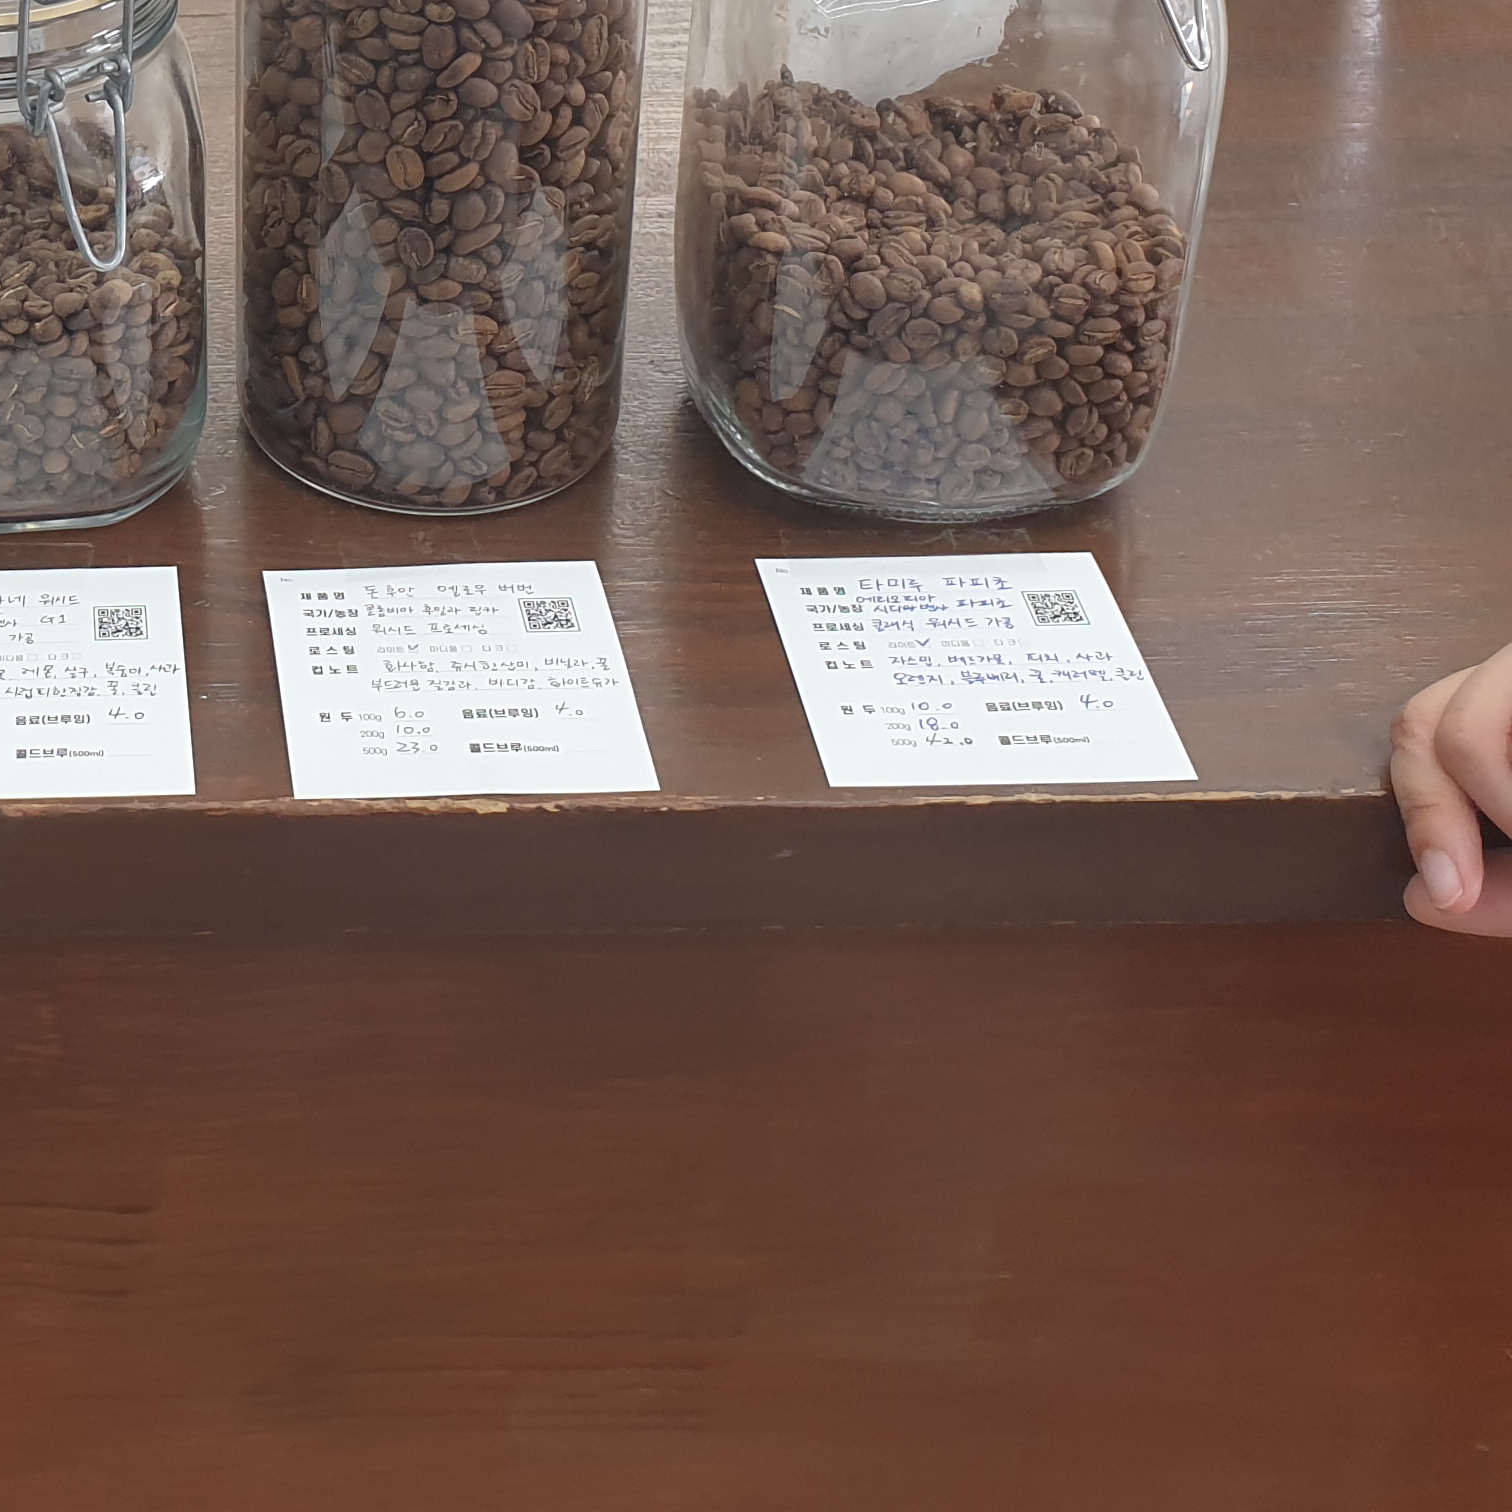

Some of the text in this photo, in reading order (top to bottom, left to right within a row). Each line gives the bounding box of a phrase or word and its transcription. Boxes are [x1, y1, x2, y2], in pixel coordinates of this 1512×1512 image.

[498, 584, 534, 595] 버번
[858, 578, 923, 592] 타미루
[428, 623, 489, 635] 프로세싱
[1076, 652, 1114, 662] 사과
[912, 702, 953, 711] 10.0
[1080, 694, 1114, 709] 4.0
[108, 706, 145, 721] 4.0
[358, 713, 382, 722] 100g
[394, 707, 425, 719] 6.0
[555, 702, 584, 717] 4.0
[919, 718, 959, 731] 18.0
[360, 725, 431, 739] 200g 10.0
[926, 733, 974, 746] 42.0
[396, 742, 438, 753] 23.0
